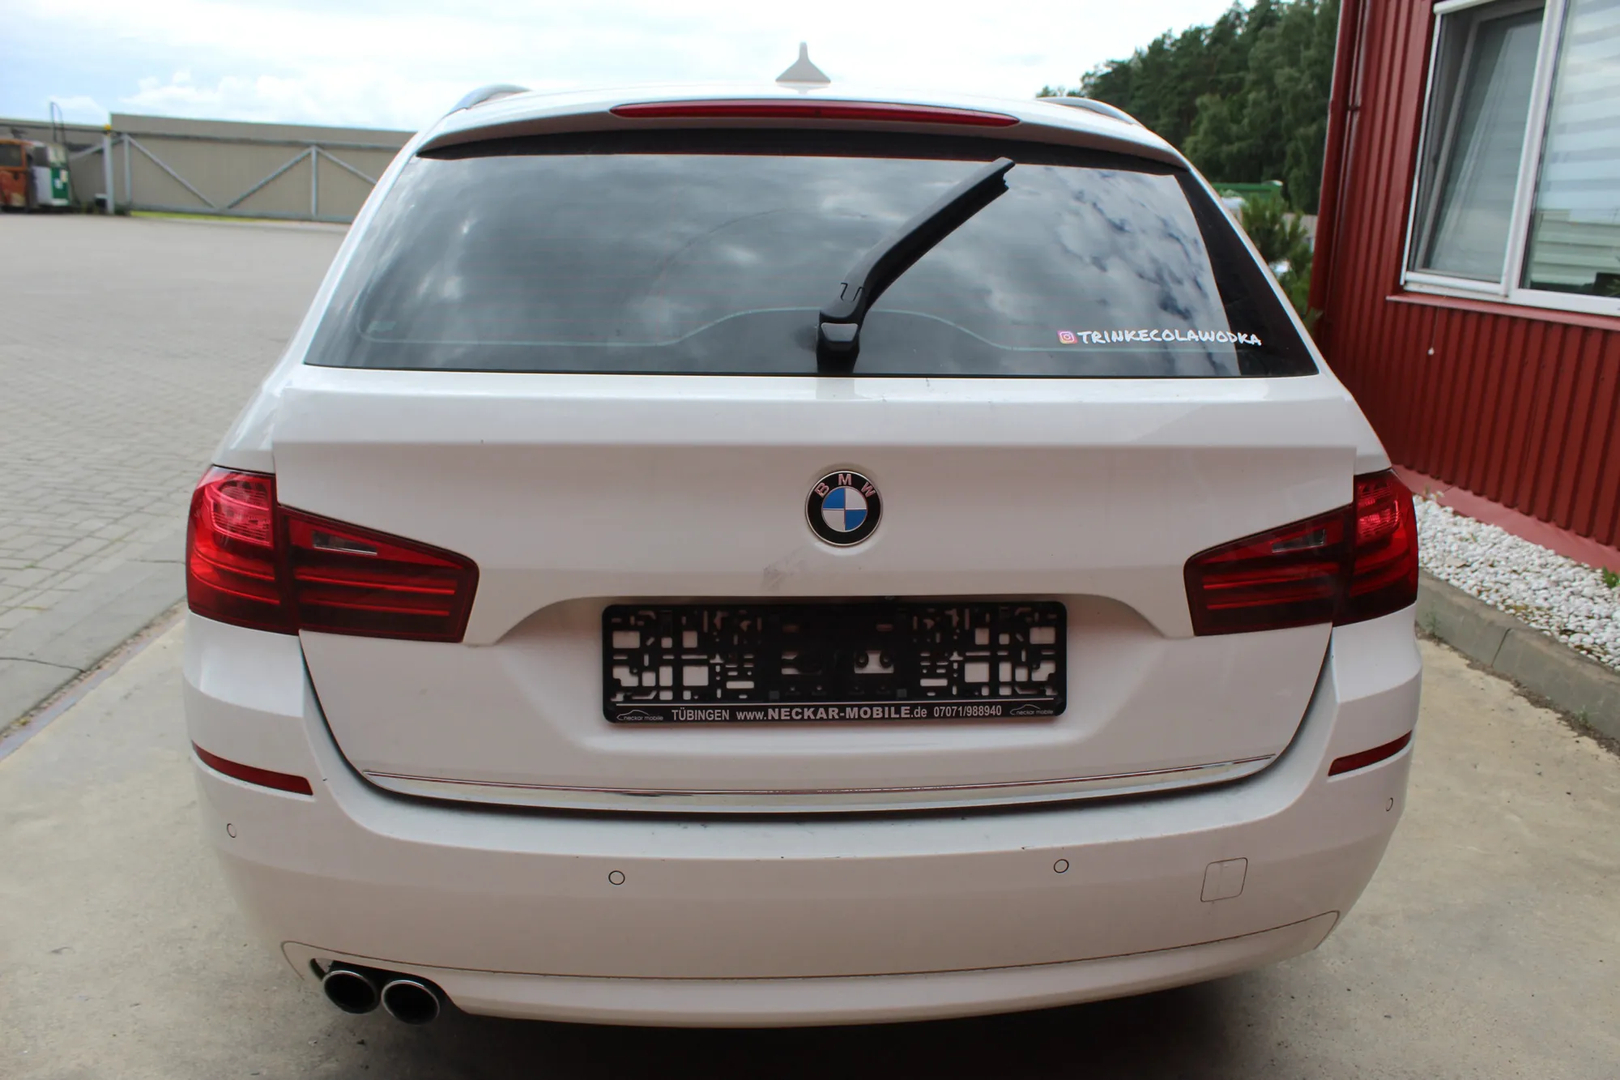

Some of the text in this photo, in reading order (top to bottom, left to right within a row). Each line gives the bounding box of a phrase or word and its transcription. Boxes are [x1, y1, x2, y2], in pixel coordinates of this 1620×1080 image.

[1077, 329, 1262, 346] TRINKECOLAWODKA
[814, 474, 876, 498] BMW
[671, 705, 1003, 721] TÜBINGEN www.NECKAR-MOBILE.de 07071/988940
